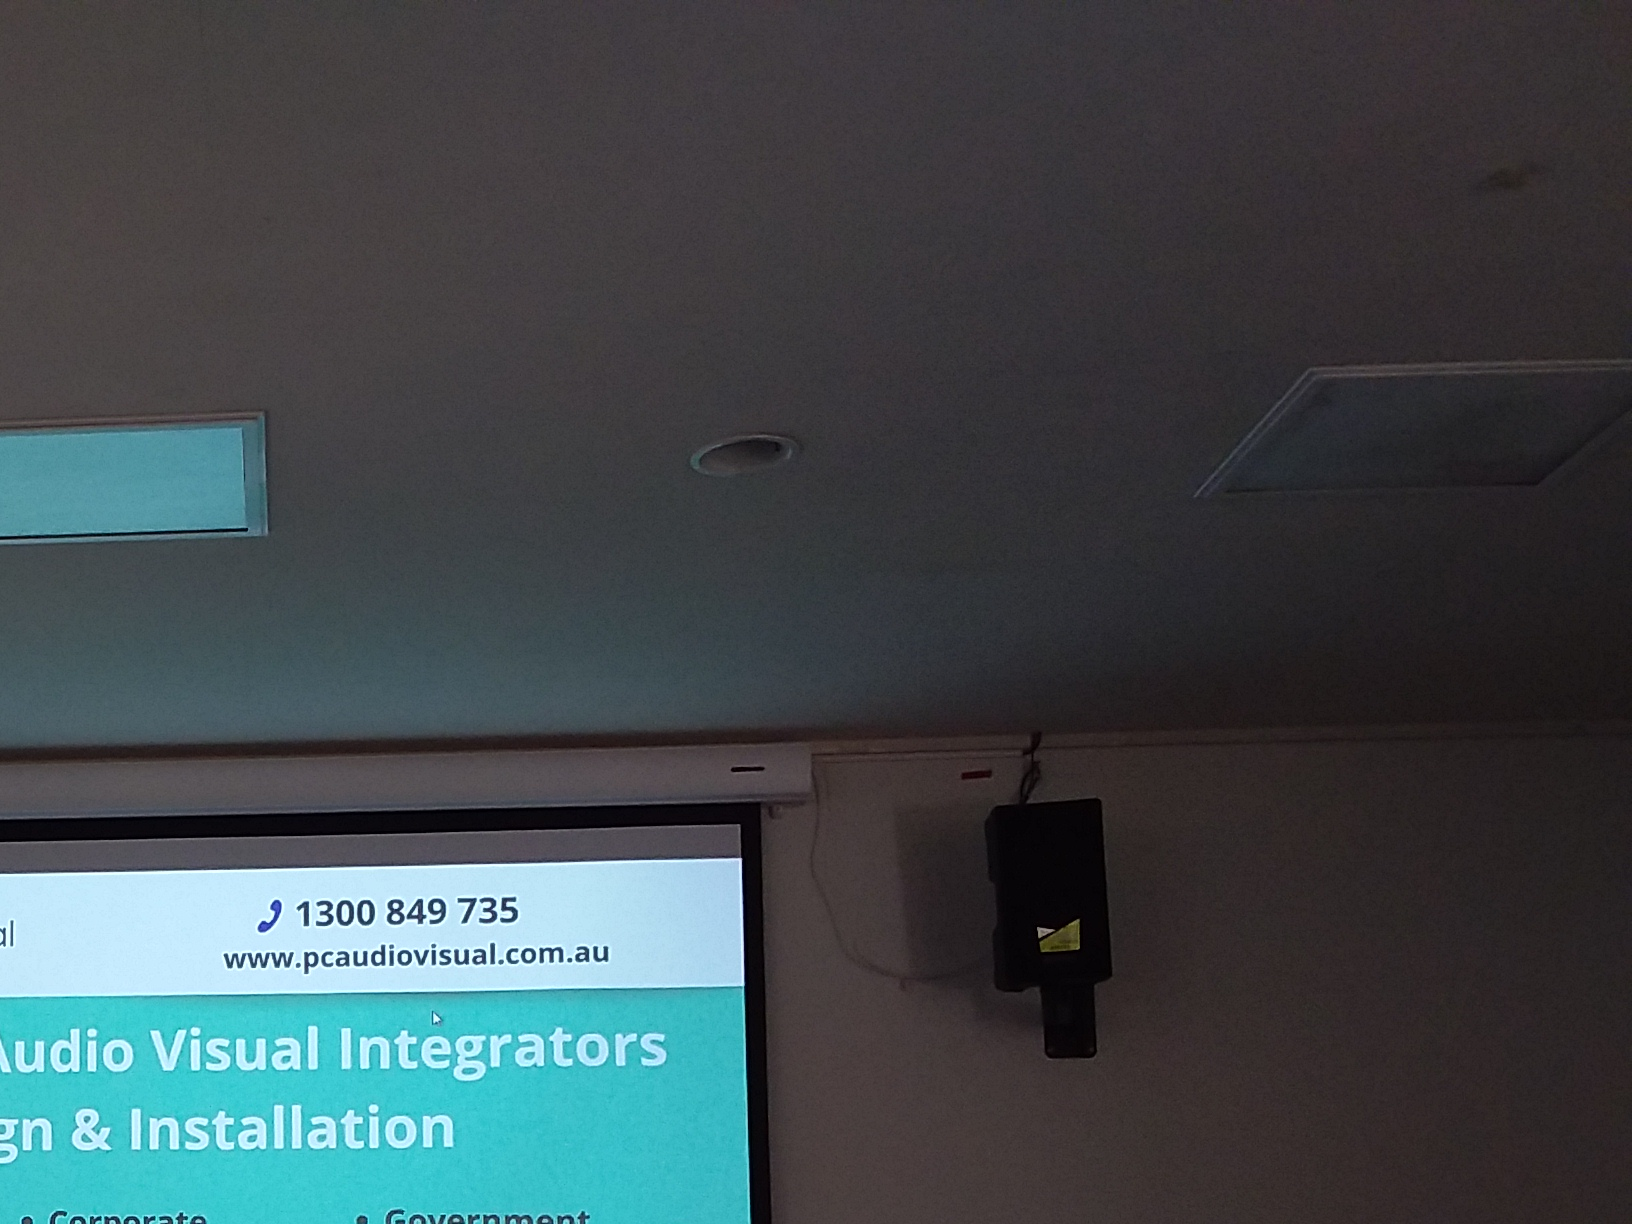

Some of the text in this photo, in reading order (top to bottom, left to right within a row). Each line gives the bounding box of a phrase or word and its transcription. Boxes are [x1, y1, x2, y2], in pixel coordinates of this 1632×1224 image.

[296, 896, 519, 927] 1300 849 735
[223, 942, 609, 975] www.pcaudiovisual.com.au
[149, 1025, 319, 1072] Visual
[340, 1024, 667, 1082] Integrators
[71, 1108, 113, 1151] &
[130, 1104, 454, 1151] Installation
